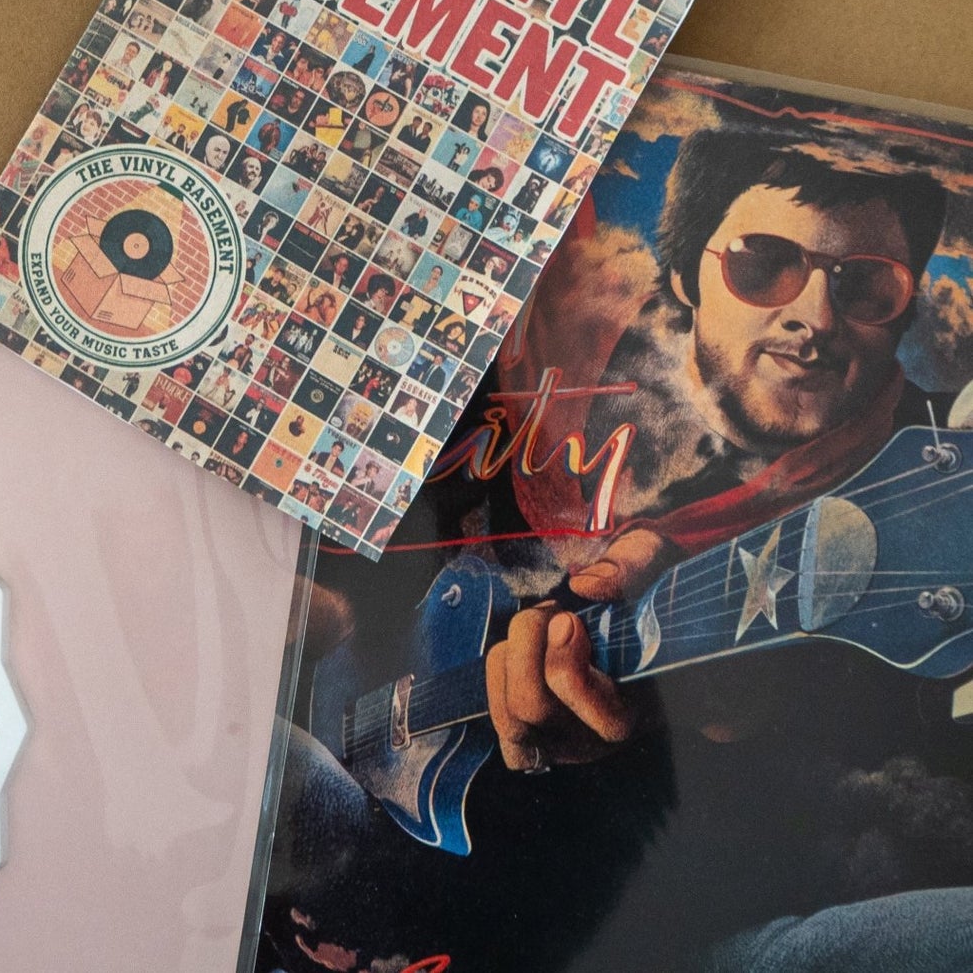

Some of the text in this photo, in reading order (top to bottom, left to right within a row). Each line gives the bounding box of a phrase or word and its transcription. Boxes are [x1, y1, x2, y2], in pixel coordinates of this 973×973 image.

[75, 156, 235, 275] THE VINYL BASEMENT
[30, 252, 52, 307] EXPAND
[49, 306, 80, 340] YOUR
[82, 336, 127, 359] MUSIC
[132, 339, 179, 360] TASTE
